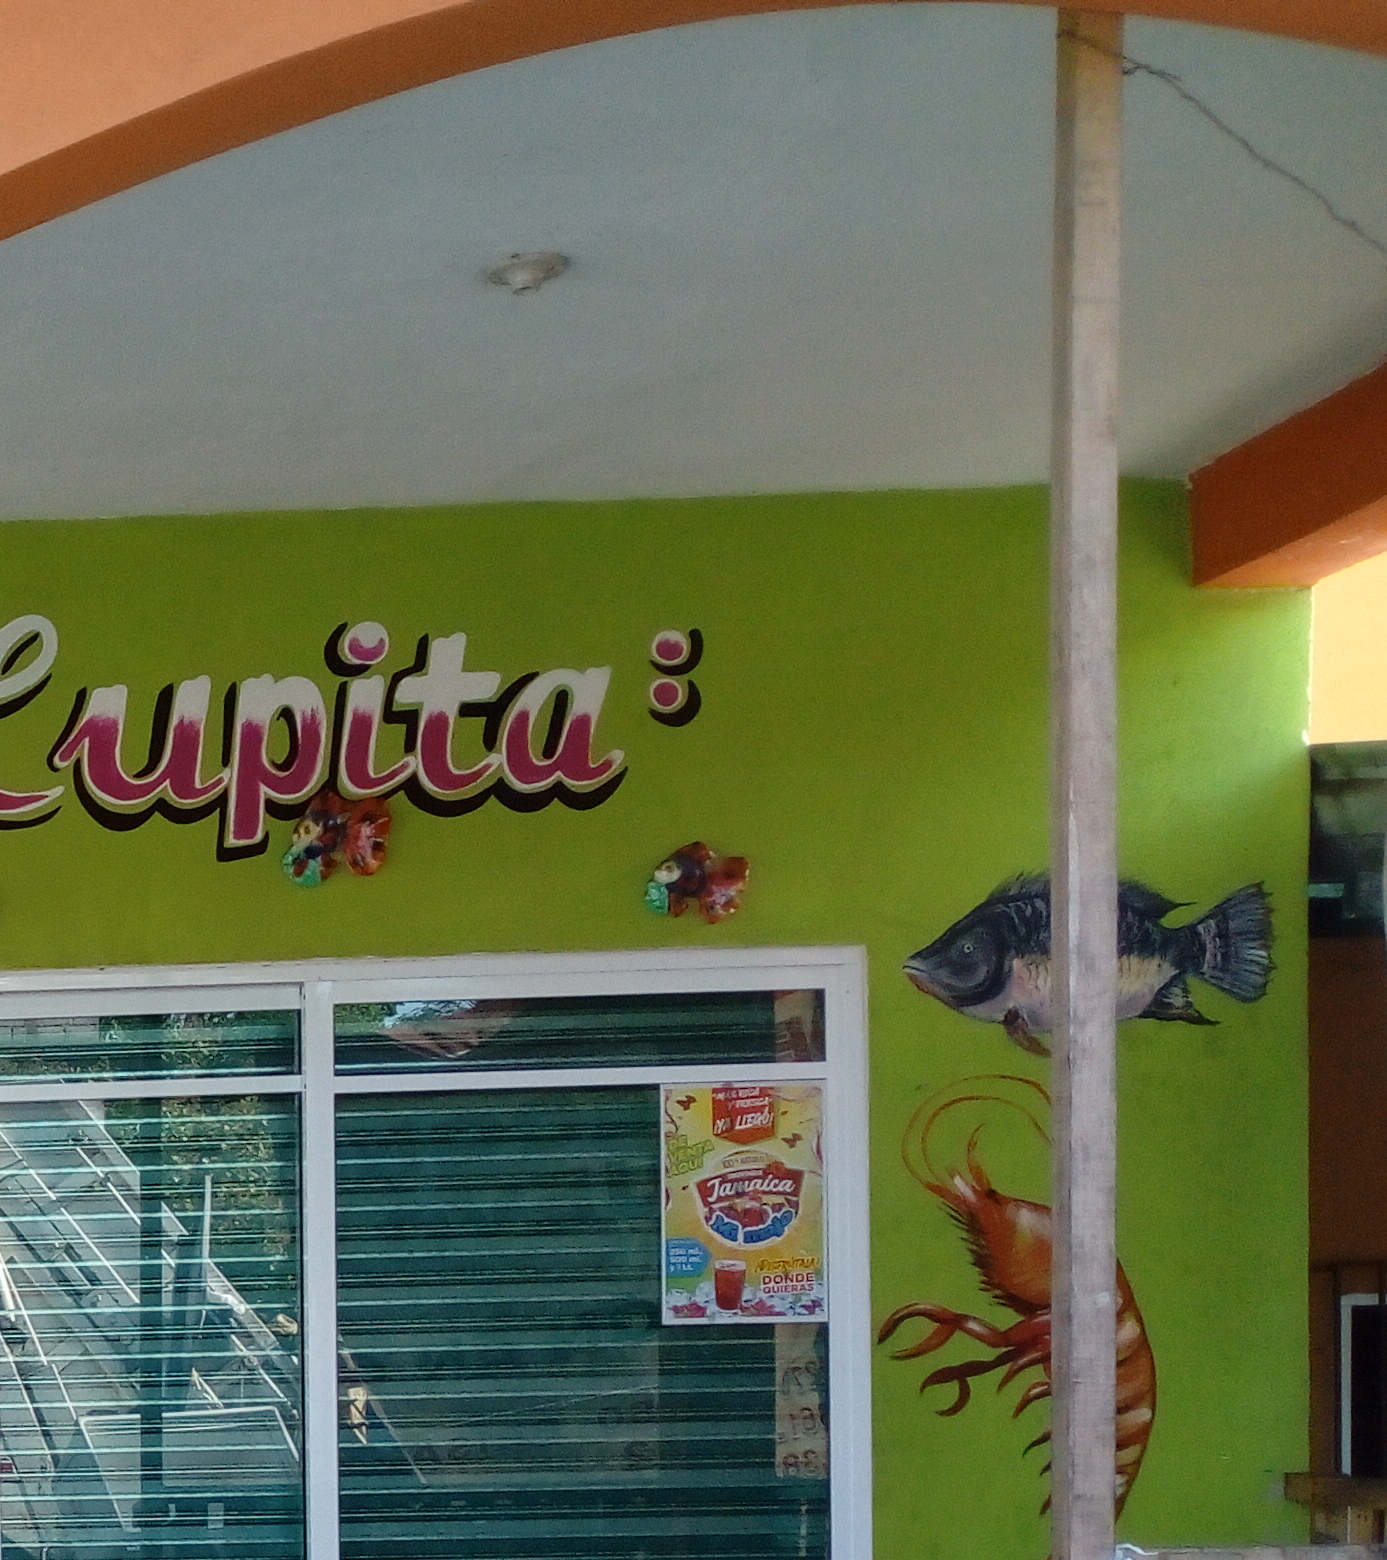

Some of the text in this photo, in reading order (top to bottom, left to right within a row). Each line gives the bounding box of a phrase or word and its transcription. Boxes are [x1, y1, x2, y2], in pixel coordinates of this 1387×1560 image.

[707, 1174, 795, 1202] Jamaica
[762, 1272, 815, 1285] DONDE
[763, 1283, 814, 1294] QUIERAS
